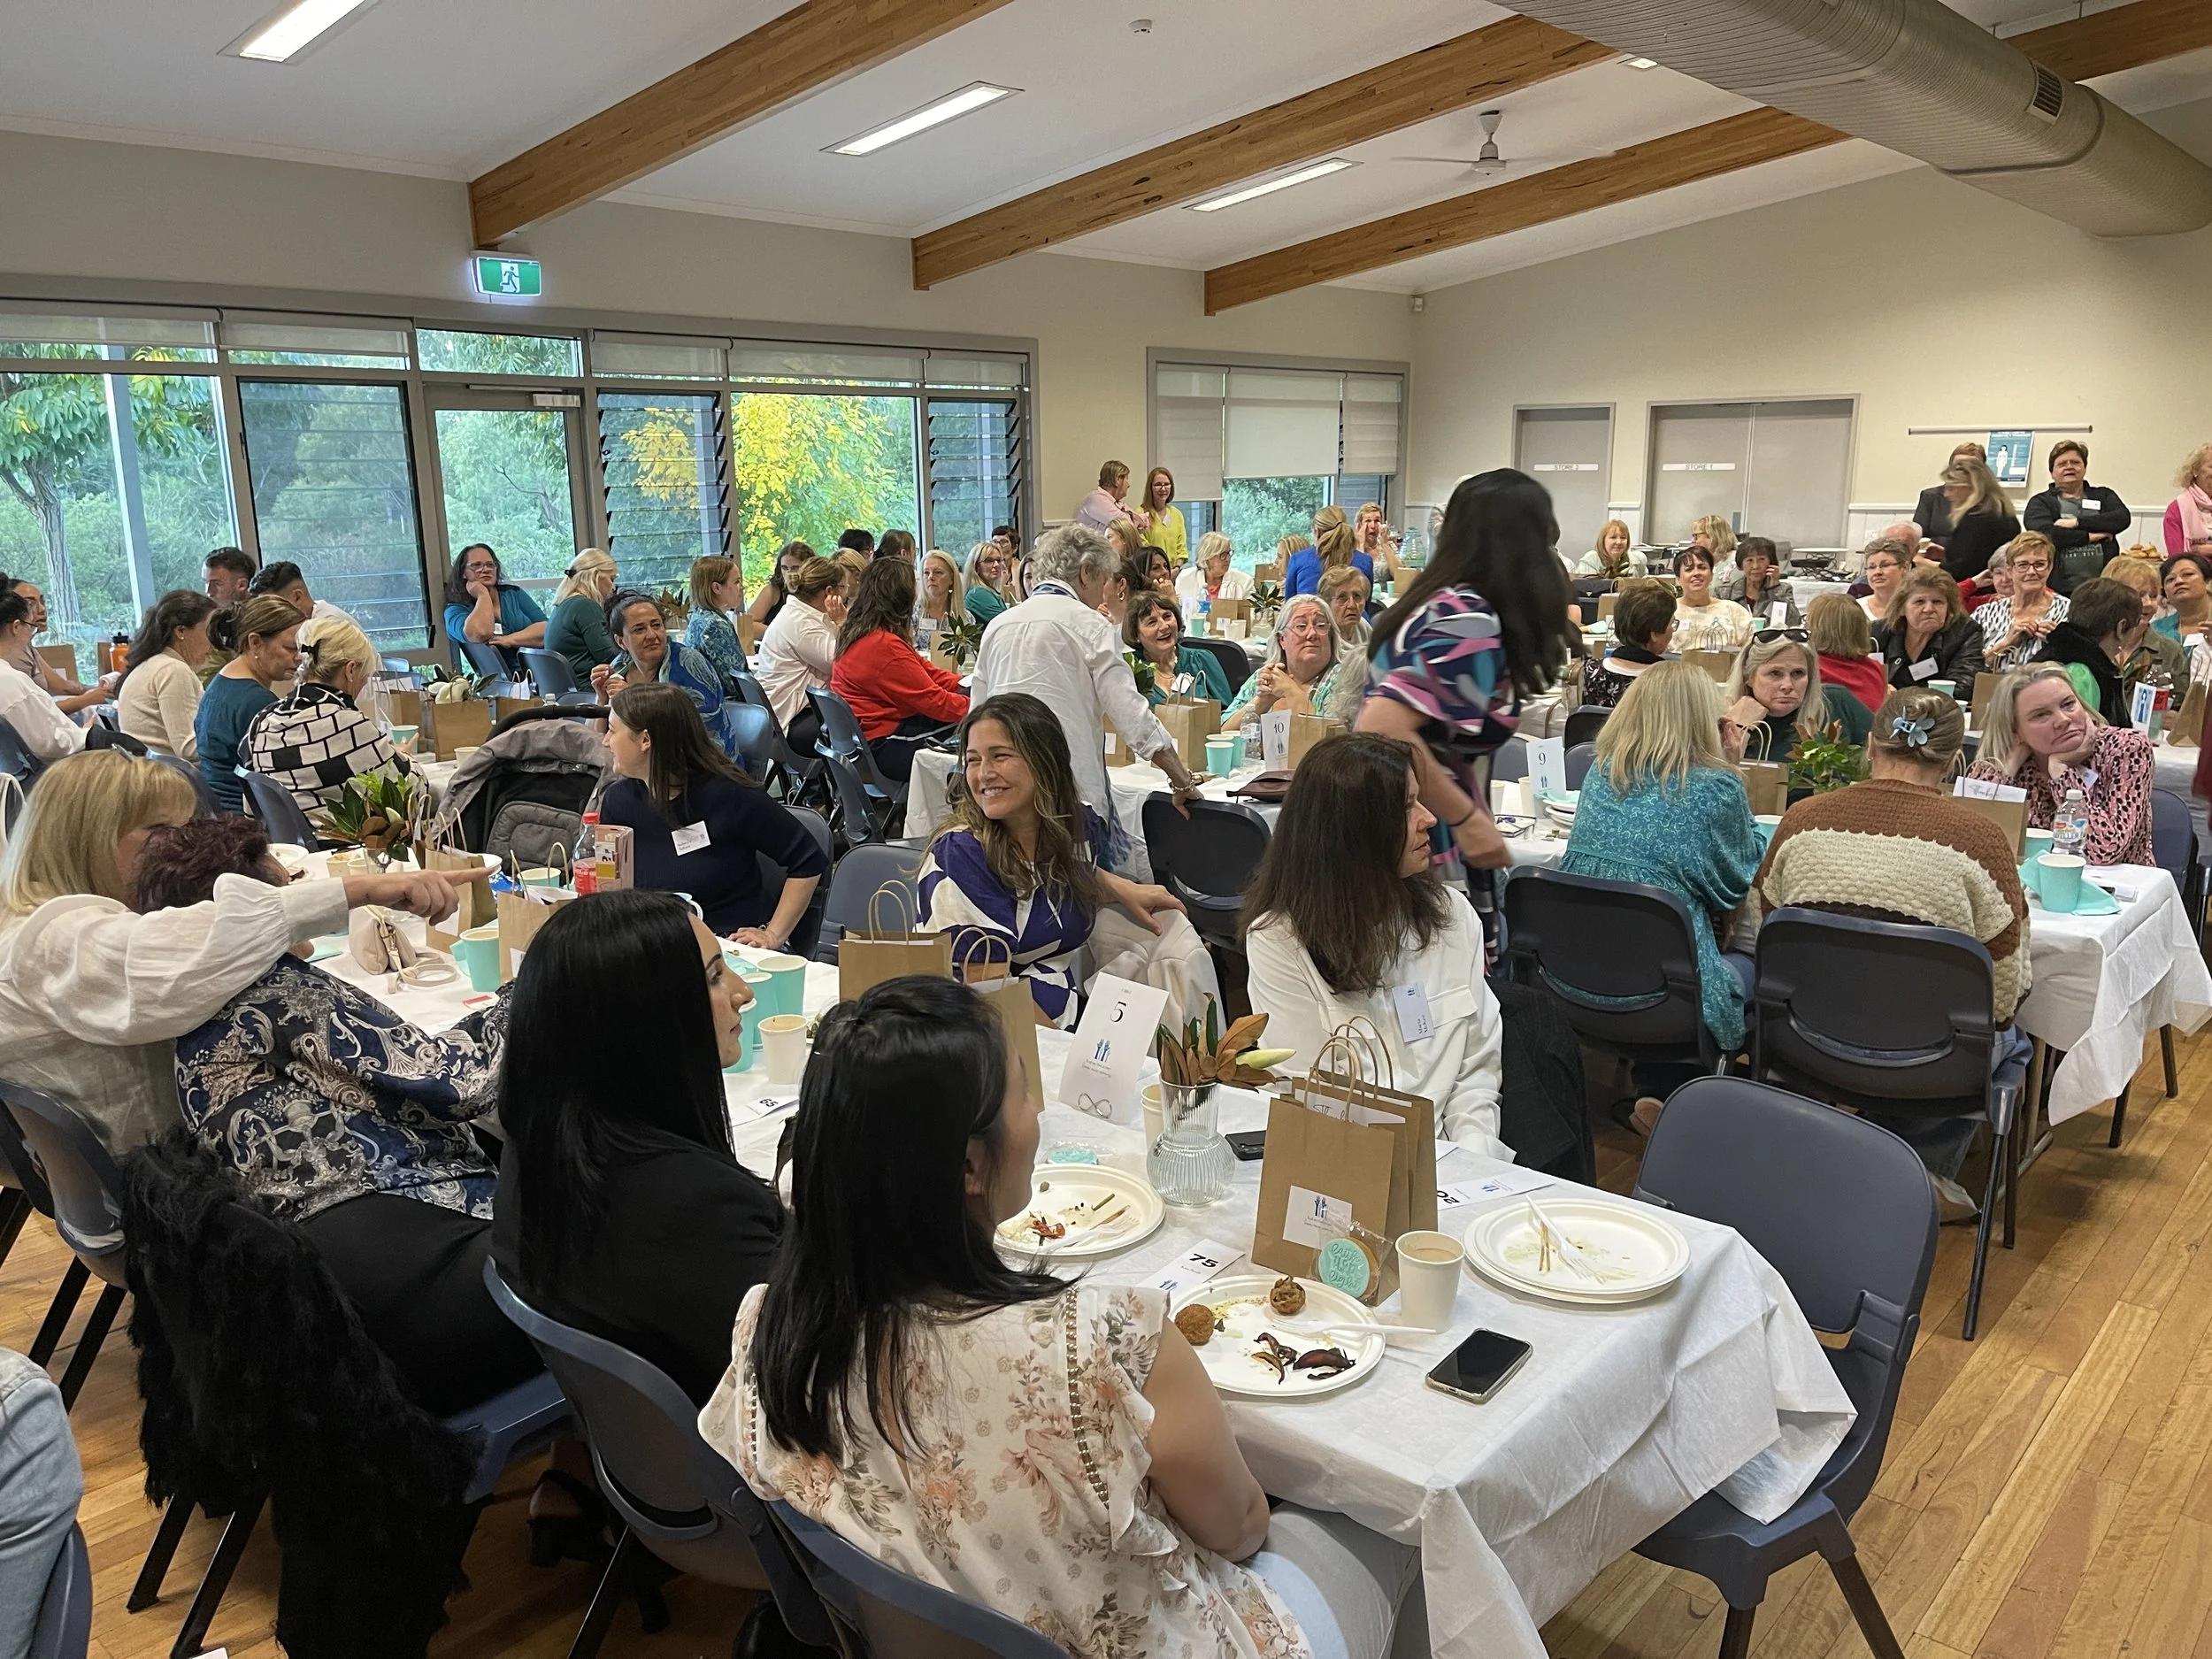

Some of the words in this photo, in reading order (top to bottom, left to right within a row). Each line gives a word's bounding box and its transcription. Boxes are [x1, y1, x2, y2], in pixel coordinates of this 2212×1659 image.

[1274, 722, 1285, 734] 10
[1539, 752, 1547, 765] 9
[1110, 1001, 1127, 1023] 5
[759, 1098, 779, 1108] 65
[1189, 1253, 1219, 1268] 75
